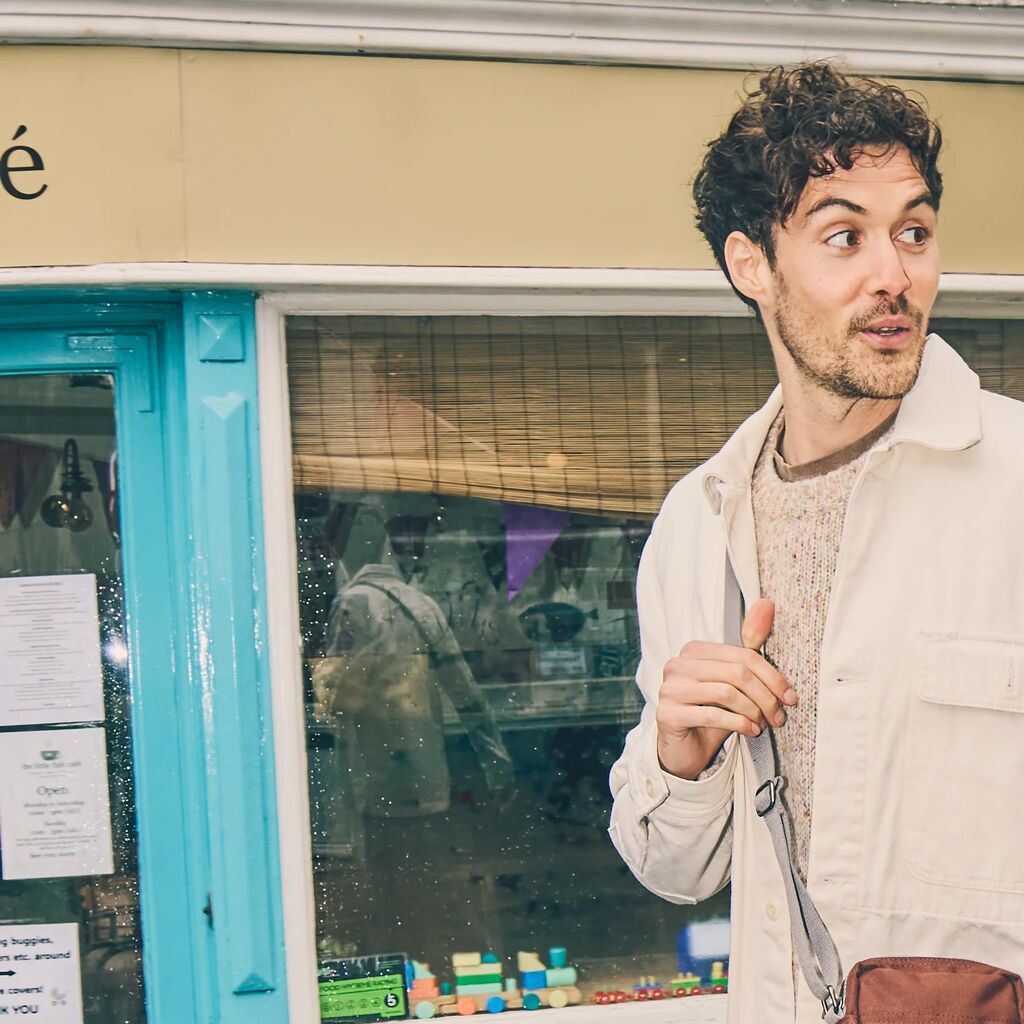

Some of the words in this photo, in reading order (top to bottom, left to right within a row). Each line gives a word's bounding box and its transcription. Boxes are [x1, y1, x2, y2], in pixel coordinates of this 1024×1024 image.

[37, 786, 68, 797] Open
[35, 951, 71, 960] around
[387, 993, 397, 1007] 5
[13, 1005, 38, 1014] YOU
